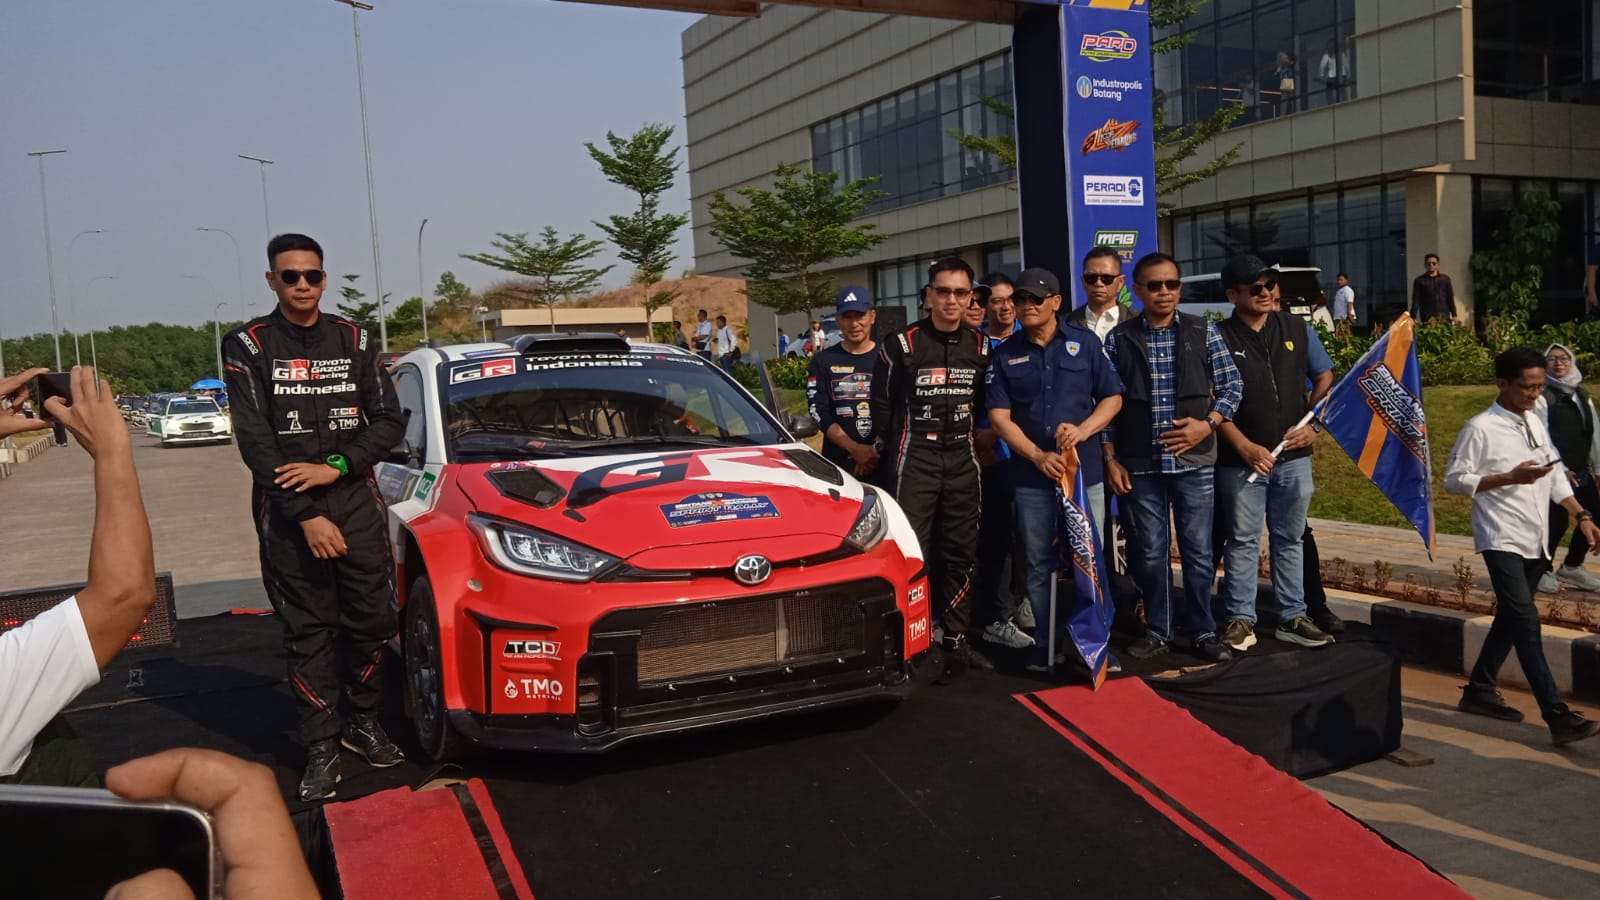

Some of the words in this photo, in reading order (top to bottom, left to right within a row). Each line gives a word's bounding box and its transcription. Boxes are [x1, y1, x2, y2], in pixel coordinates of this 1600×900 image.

[1092, 78, 1143, 91] Industropolis
[1093, 89, 1122, 101] Batang
[1086, 182, 1126, 192] PERADI
[1097, 233, 1135, 245] MAB
[311, 358, 352, 366] TOYOTA
[525, 354, 592, 362] TOYOTA
[655, 355, 704, 366] Racing
[526, 360, 643, 371] Indonesia
[274, 367, 308, 379] GR
[310, 364, 350, 373] GAZOO
[453, 364, 514, 382] GR
[311, 371, 349, 380] Racing
[917, 374, 946, 385] GR
[273, 381, 357, 395] Indonesia
[1360, 378, 1424, 437] SPRINT
[338, 418, 359, 428] TMO
[909, 616, 927, 640] TMO
[508, 641, 556, 655] TCD
[520, 678, 563, 696] TMO
